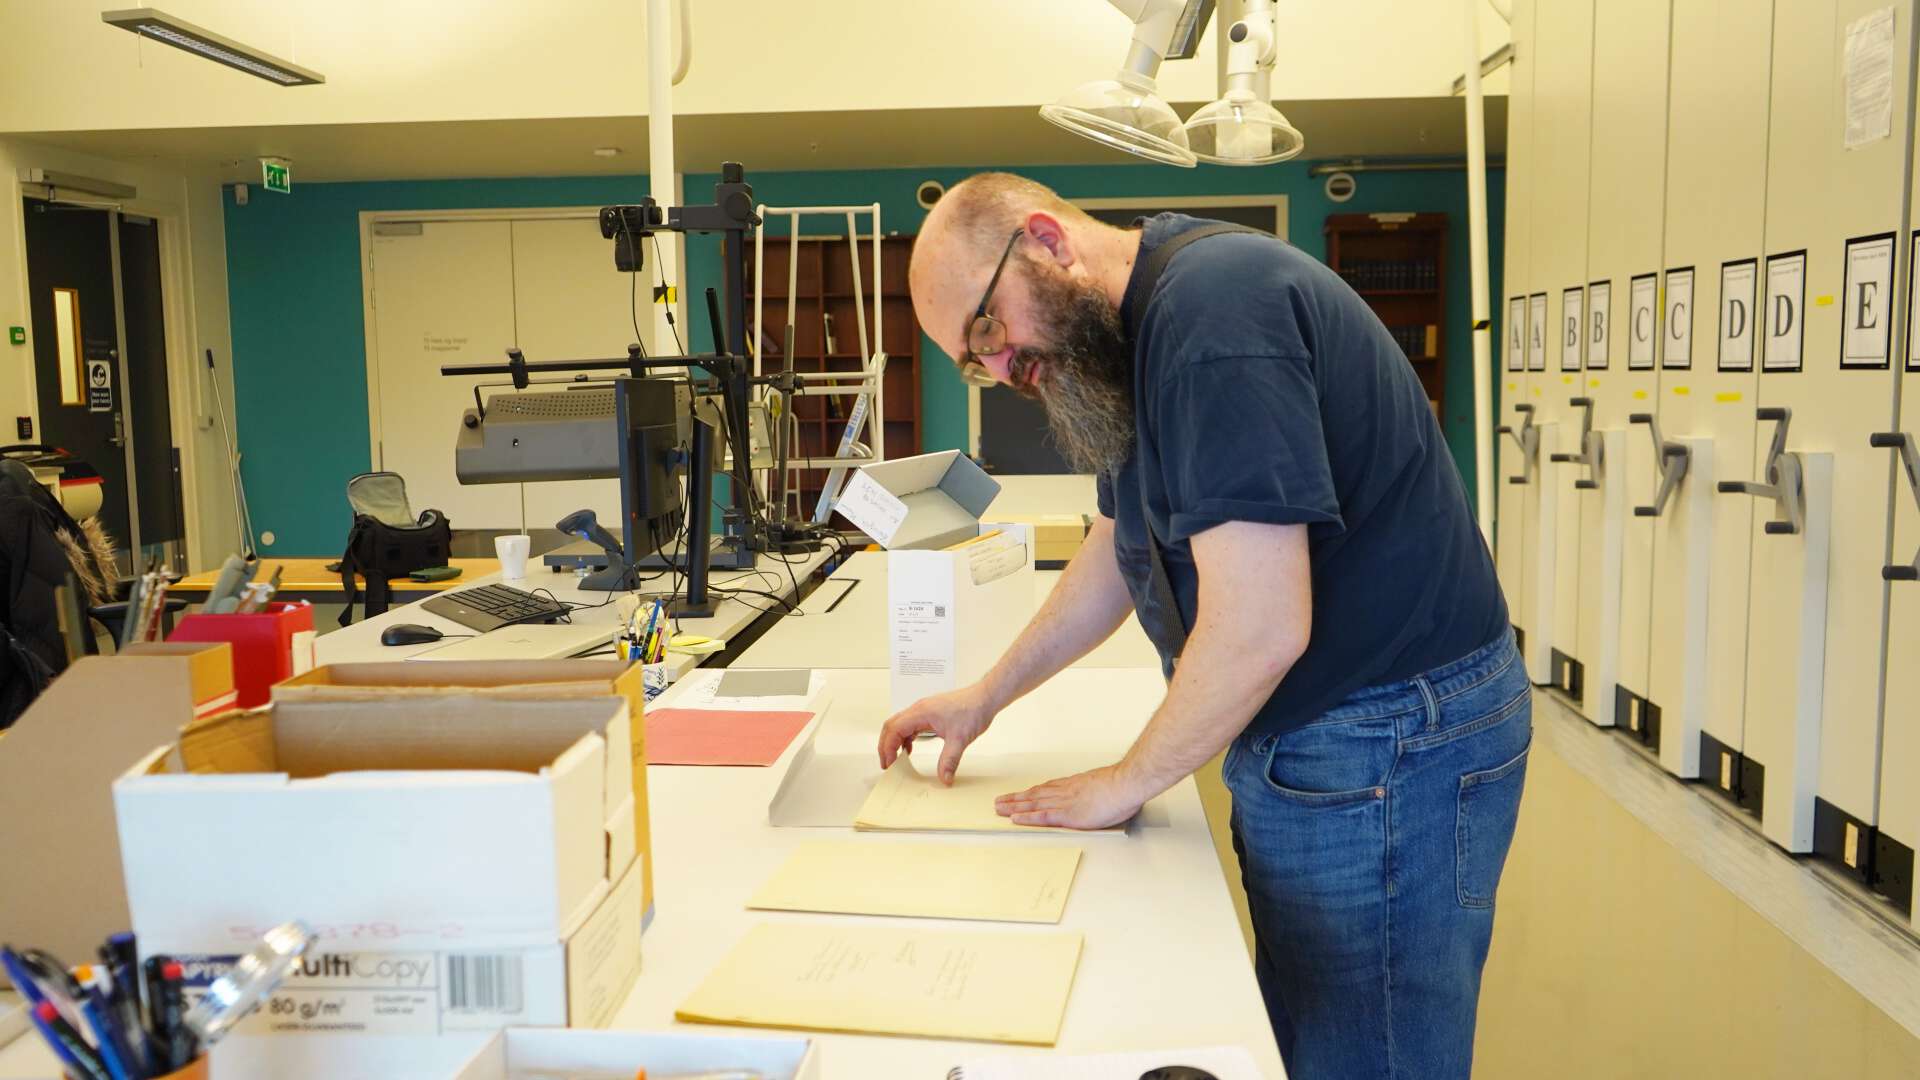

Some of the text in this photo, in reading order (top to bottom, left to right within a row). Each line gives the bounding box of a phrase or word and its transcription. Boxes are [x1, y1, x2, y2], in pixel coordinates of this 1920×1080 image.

[1671, 302, 1686, 340] C
[1727, 299, 1746, 339] D
[1773, 294, 1794, 338] D
[1855, 281, 1878, 330] E
[1512, 324, 1521, 350] A
[1533, 320, 1541, 349] A
[1567, 316, 1577, 347] B
[1593, 311, 1604, 343] B
[1636, 306, 1650, 342] C
[293, 953, 430, 986] ultiCopy
[270, 997, 295, 1015] 80
